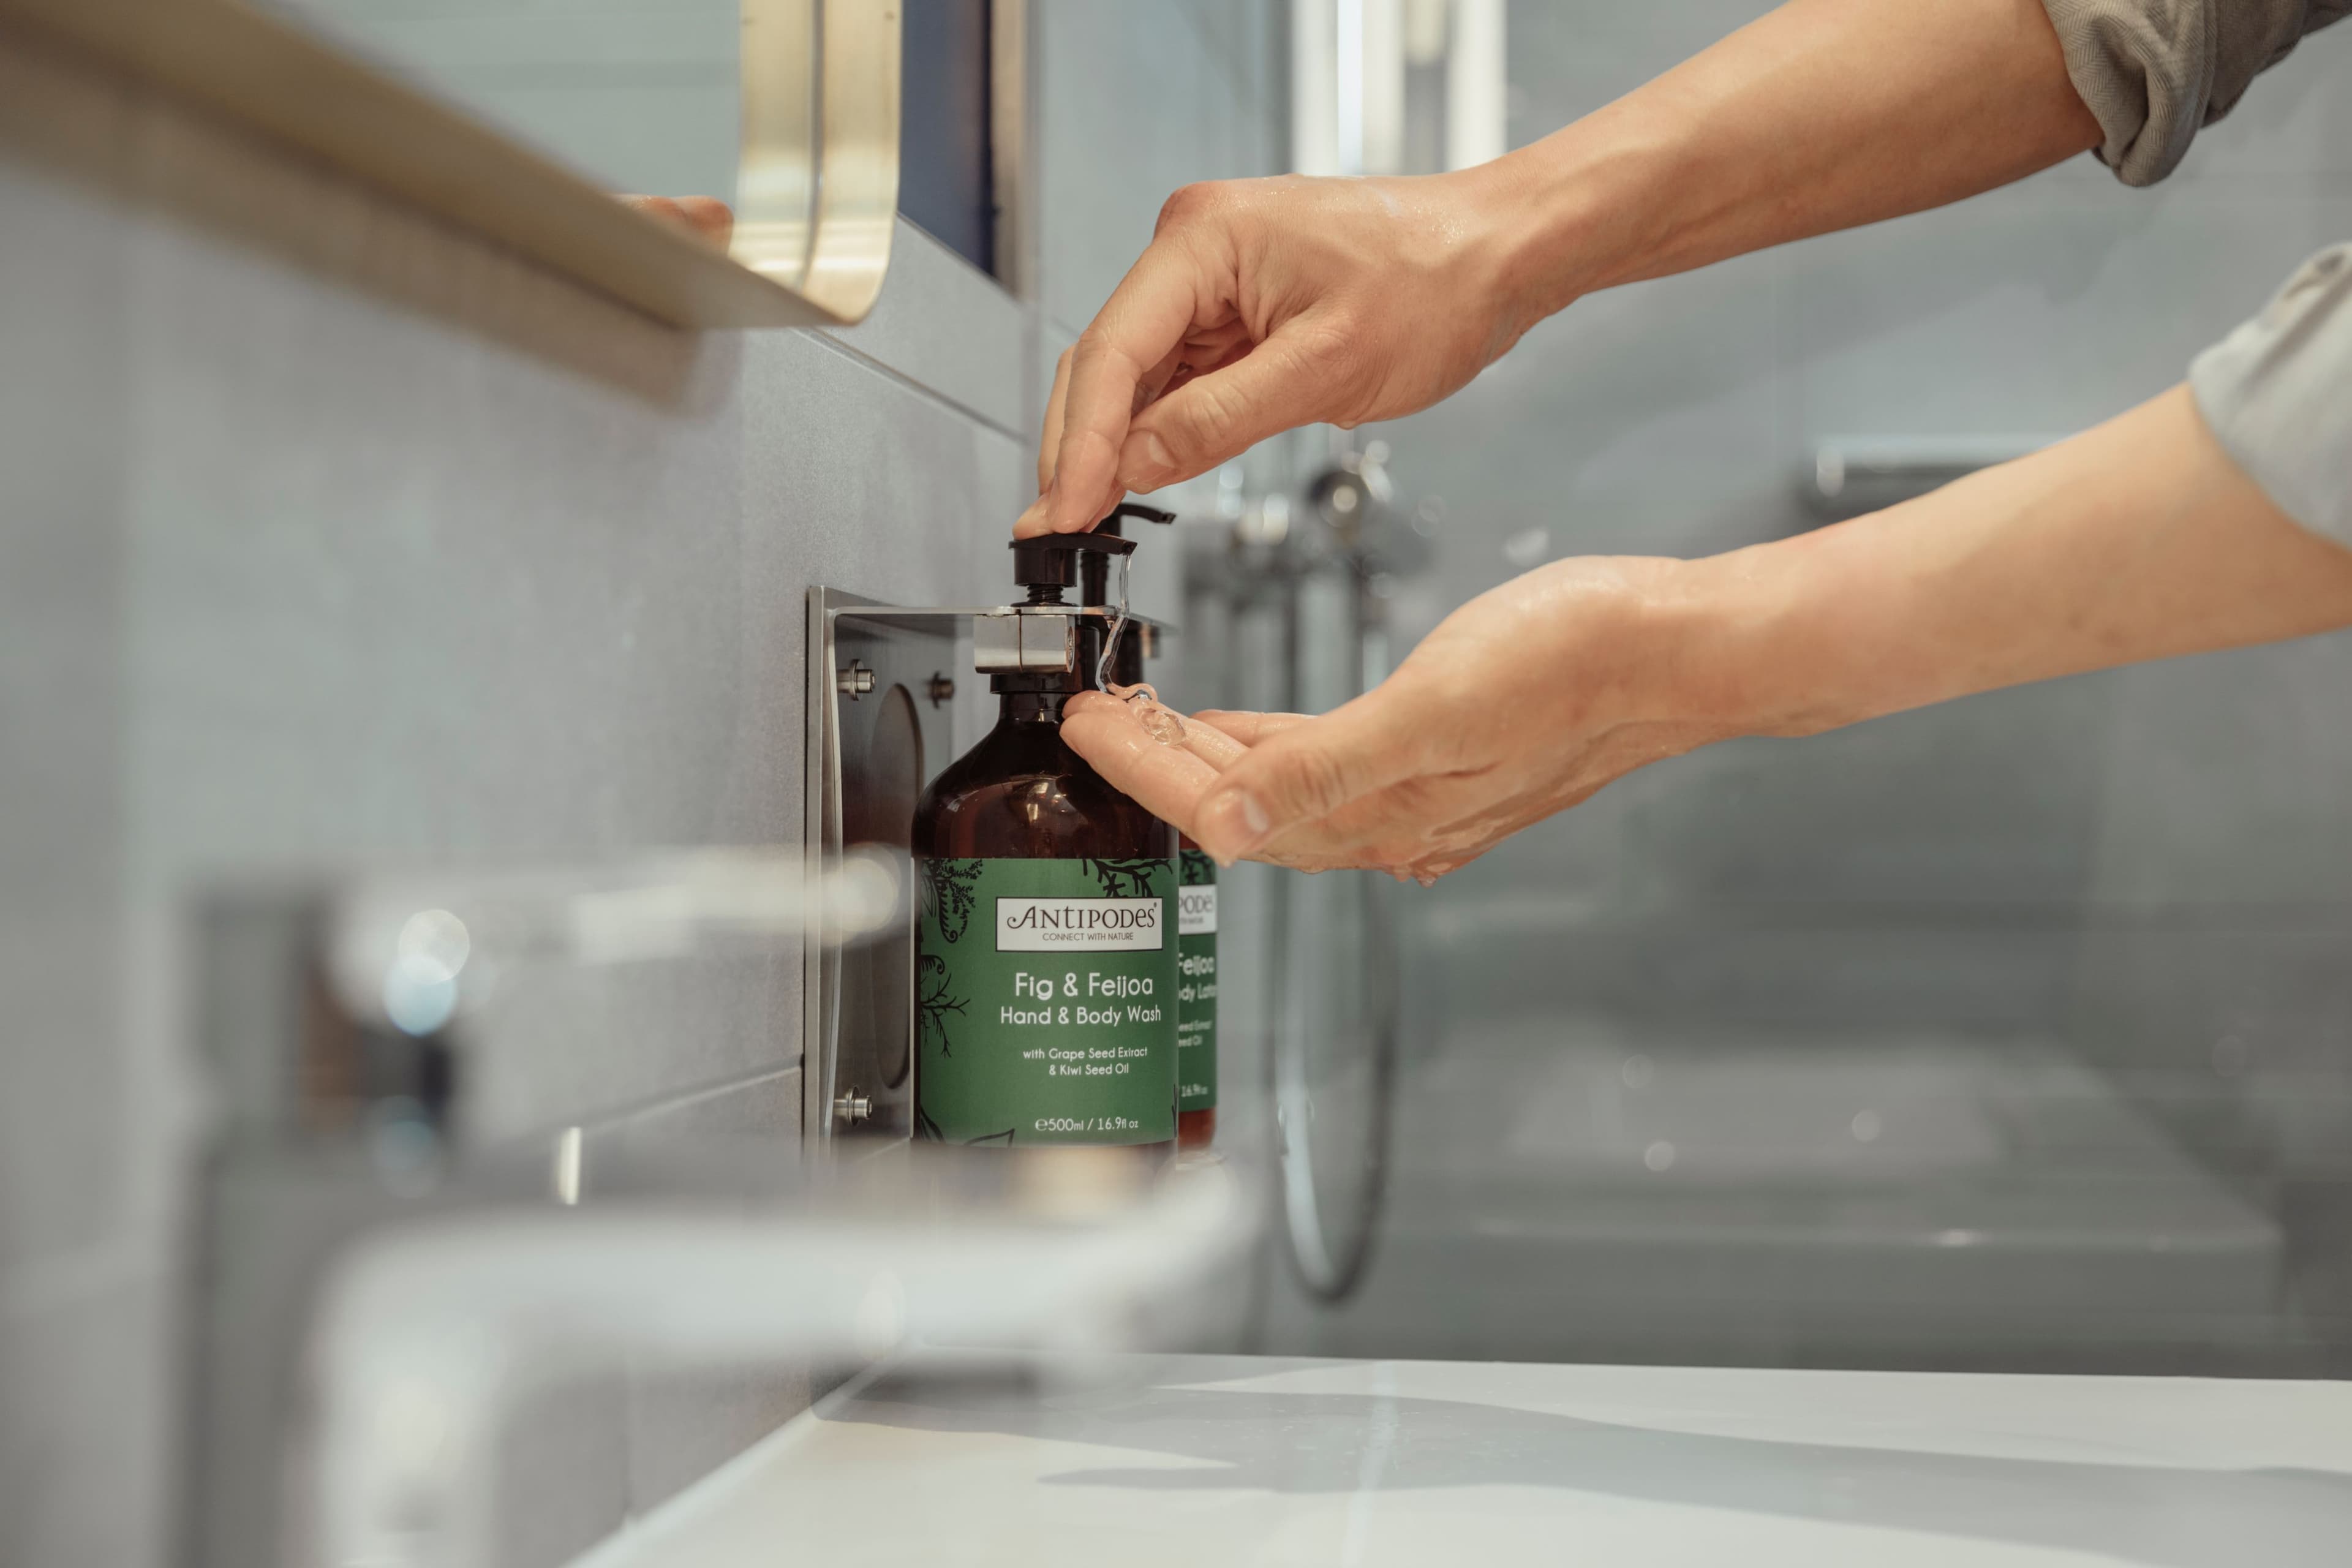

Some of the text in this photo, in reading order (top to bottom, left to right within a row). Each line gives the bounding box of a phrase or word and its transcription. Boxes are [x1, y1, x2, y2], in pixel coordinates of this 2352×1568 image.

[1042, 933, 1085, 941] CONNECT
[1107, 932, 1134, 941] NATURE
[1016, 972, 1153, 1001] Fig & Feijoa
[1001, 1005, 1161, 1027] Hand & Body Wash
[1023, 1047, 1148, 1061] with Grape Seed Extract
[1049, 1063, 1129, 1076] & Kiwi Seed Oil
[1087, 1118, 1094, 1131] /
[1098, 1117, 1126, 1131] 16.9fl
[1129, 1120, 1139, 1129] oz
